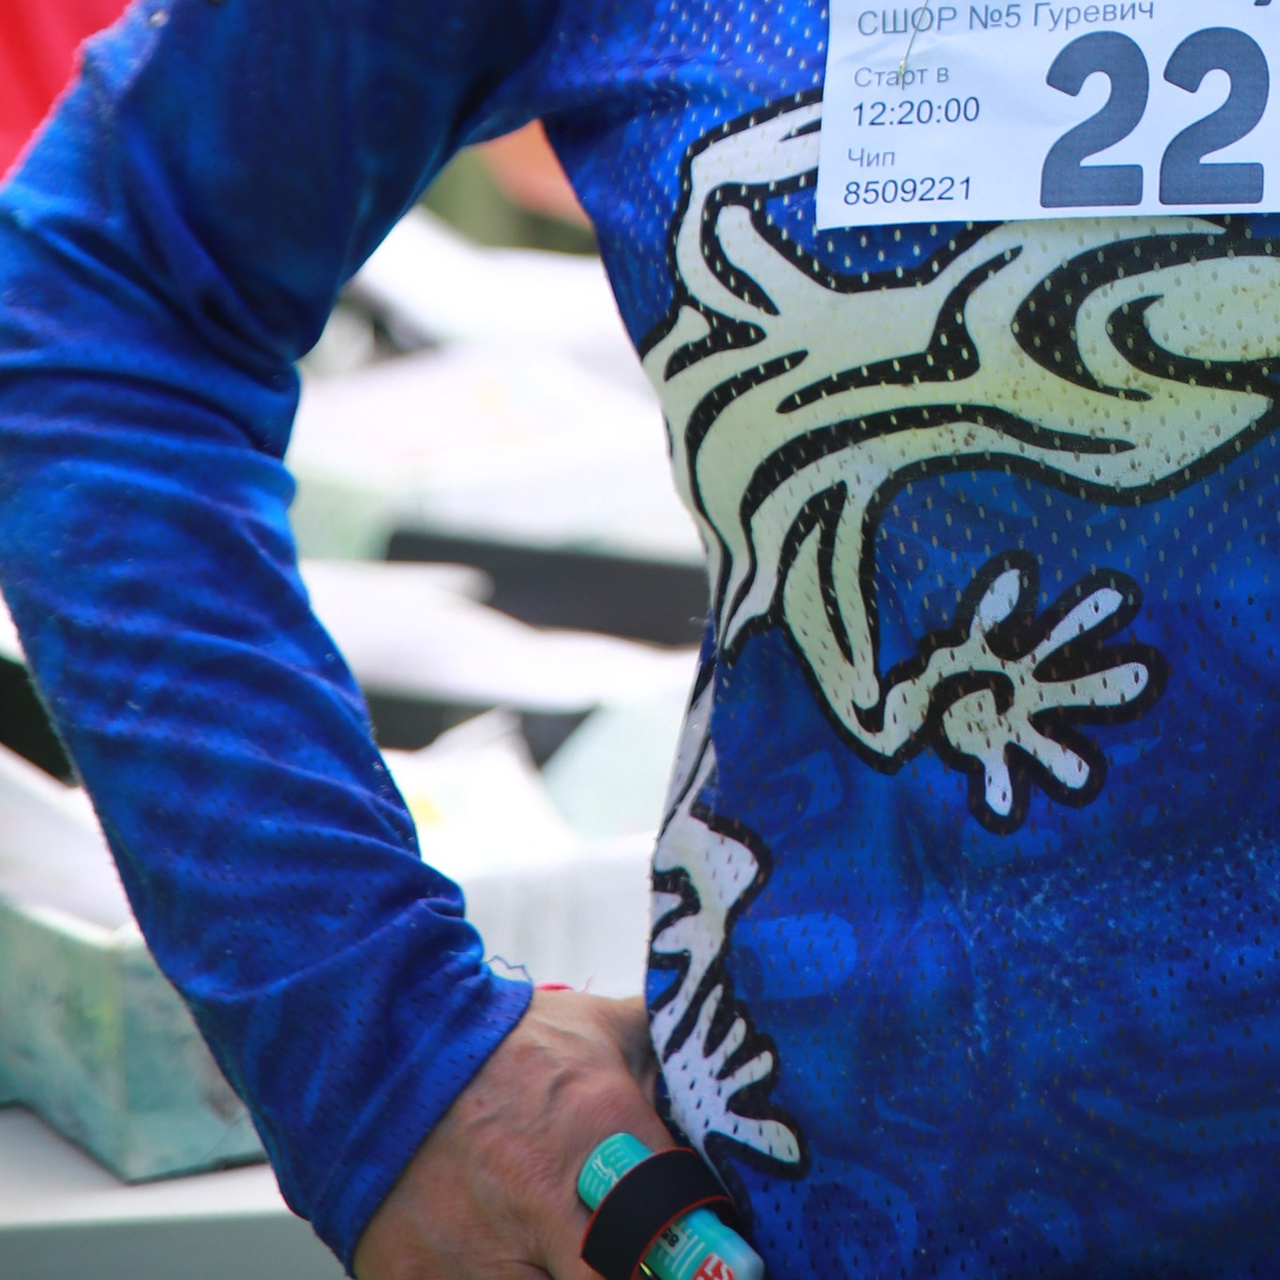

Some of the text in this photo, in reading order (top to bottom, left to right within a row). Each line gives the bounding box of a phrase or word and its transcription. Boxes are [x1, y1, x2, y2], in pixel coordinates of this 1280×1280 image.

[857, 1, 1155, 37] СШОР №5 Гуревич
[854, 66, 949, 91] Старт в
[853, 96, 980, 126] 12:20:00
[848, 147, 896, 168] Чип
[843, 176, 971, 206] 8509221
